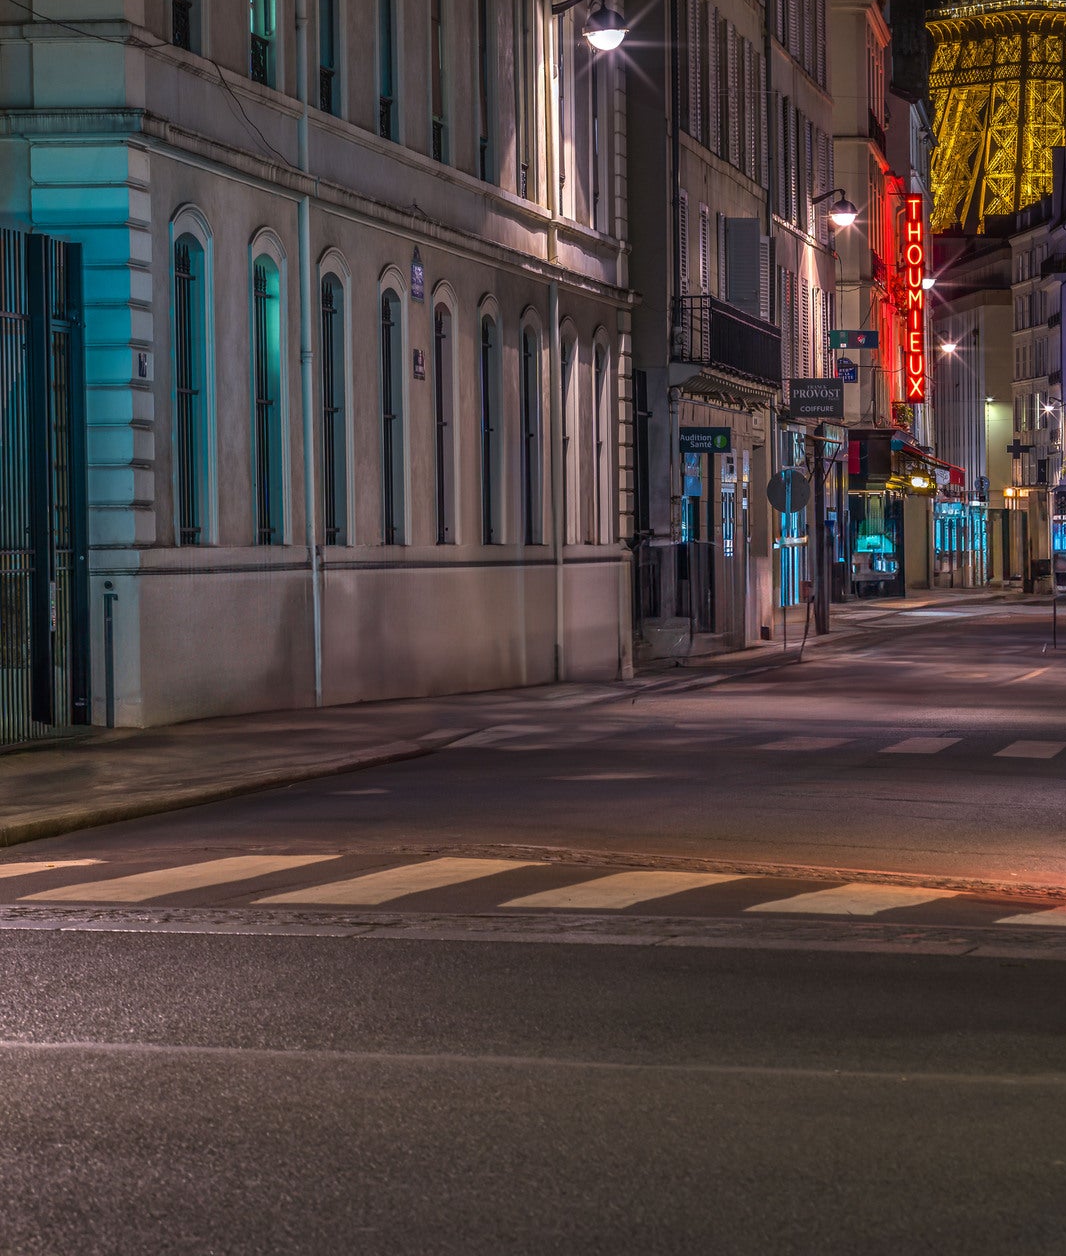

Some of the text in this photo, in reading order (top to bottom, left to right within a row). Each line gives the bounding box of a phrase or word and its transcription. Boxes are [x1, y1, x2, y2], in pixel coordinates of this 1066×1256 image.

[907, 199, 923, 397] THOUMIEUX
[793, 389, 841, 399] PROVOST
[800, 405, 834, 413] COIFFURE
[680, 434, 712, 442] Audition
